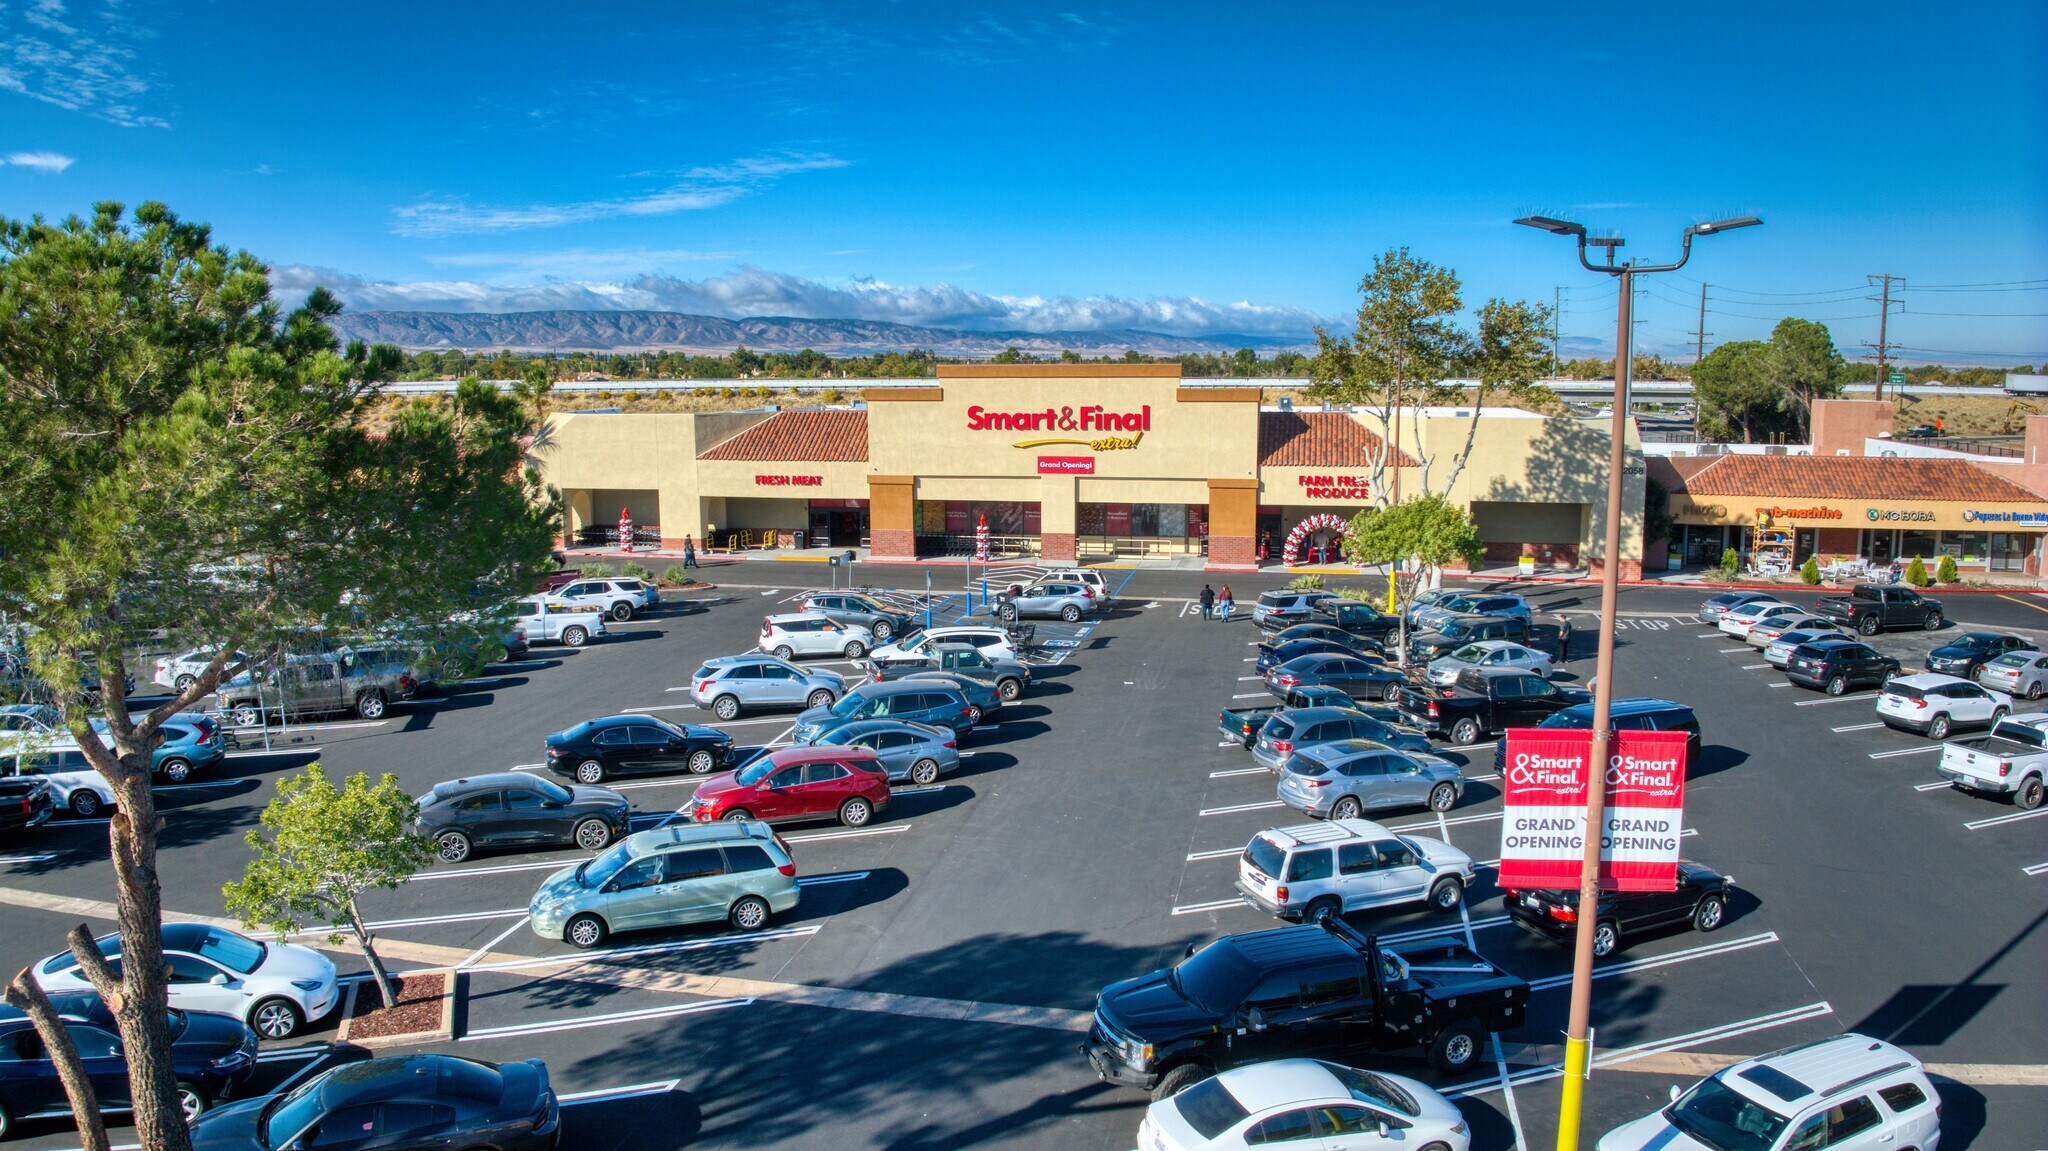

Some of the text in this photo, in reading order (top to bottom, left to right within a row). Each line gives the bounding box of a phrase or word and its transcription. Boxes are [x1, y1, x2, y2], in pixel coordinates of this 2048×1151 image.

[1089, 430, 1144, 451] extra!
[1062, 461, 1093, 470] Opening!
[1623, 467, 1644, 475] 2058
[755, 475, 824, 486] FRESH MEAT
[1299, 475, 1370, 487] FARM FRES
[1306, 487, 1369, 499] PRODUCE
[1880, 510, 1936, 522] MC BOBA
[1530, 754, 1583, 769] Smart
[1624, 755, 1678, 771] Smart
[1556, 782, 1586, 795] extra!
[1650, 784, 1680, 797] extra!
[1515, 818, 1576, 831] GRAND
[1608, 818, 1670, 833] GRAND
[1505, 835, 1582, 849] OPENING
[1601, 836, 1676, 851] OPENING
